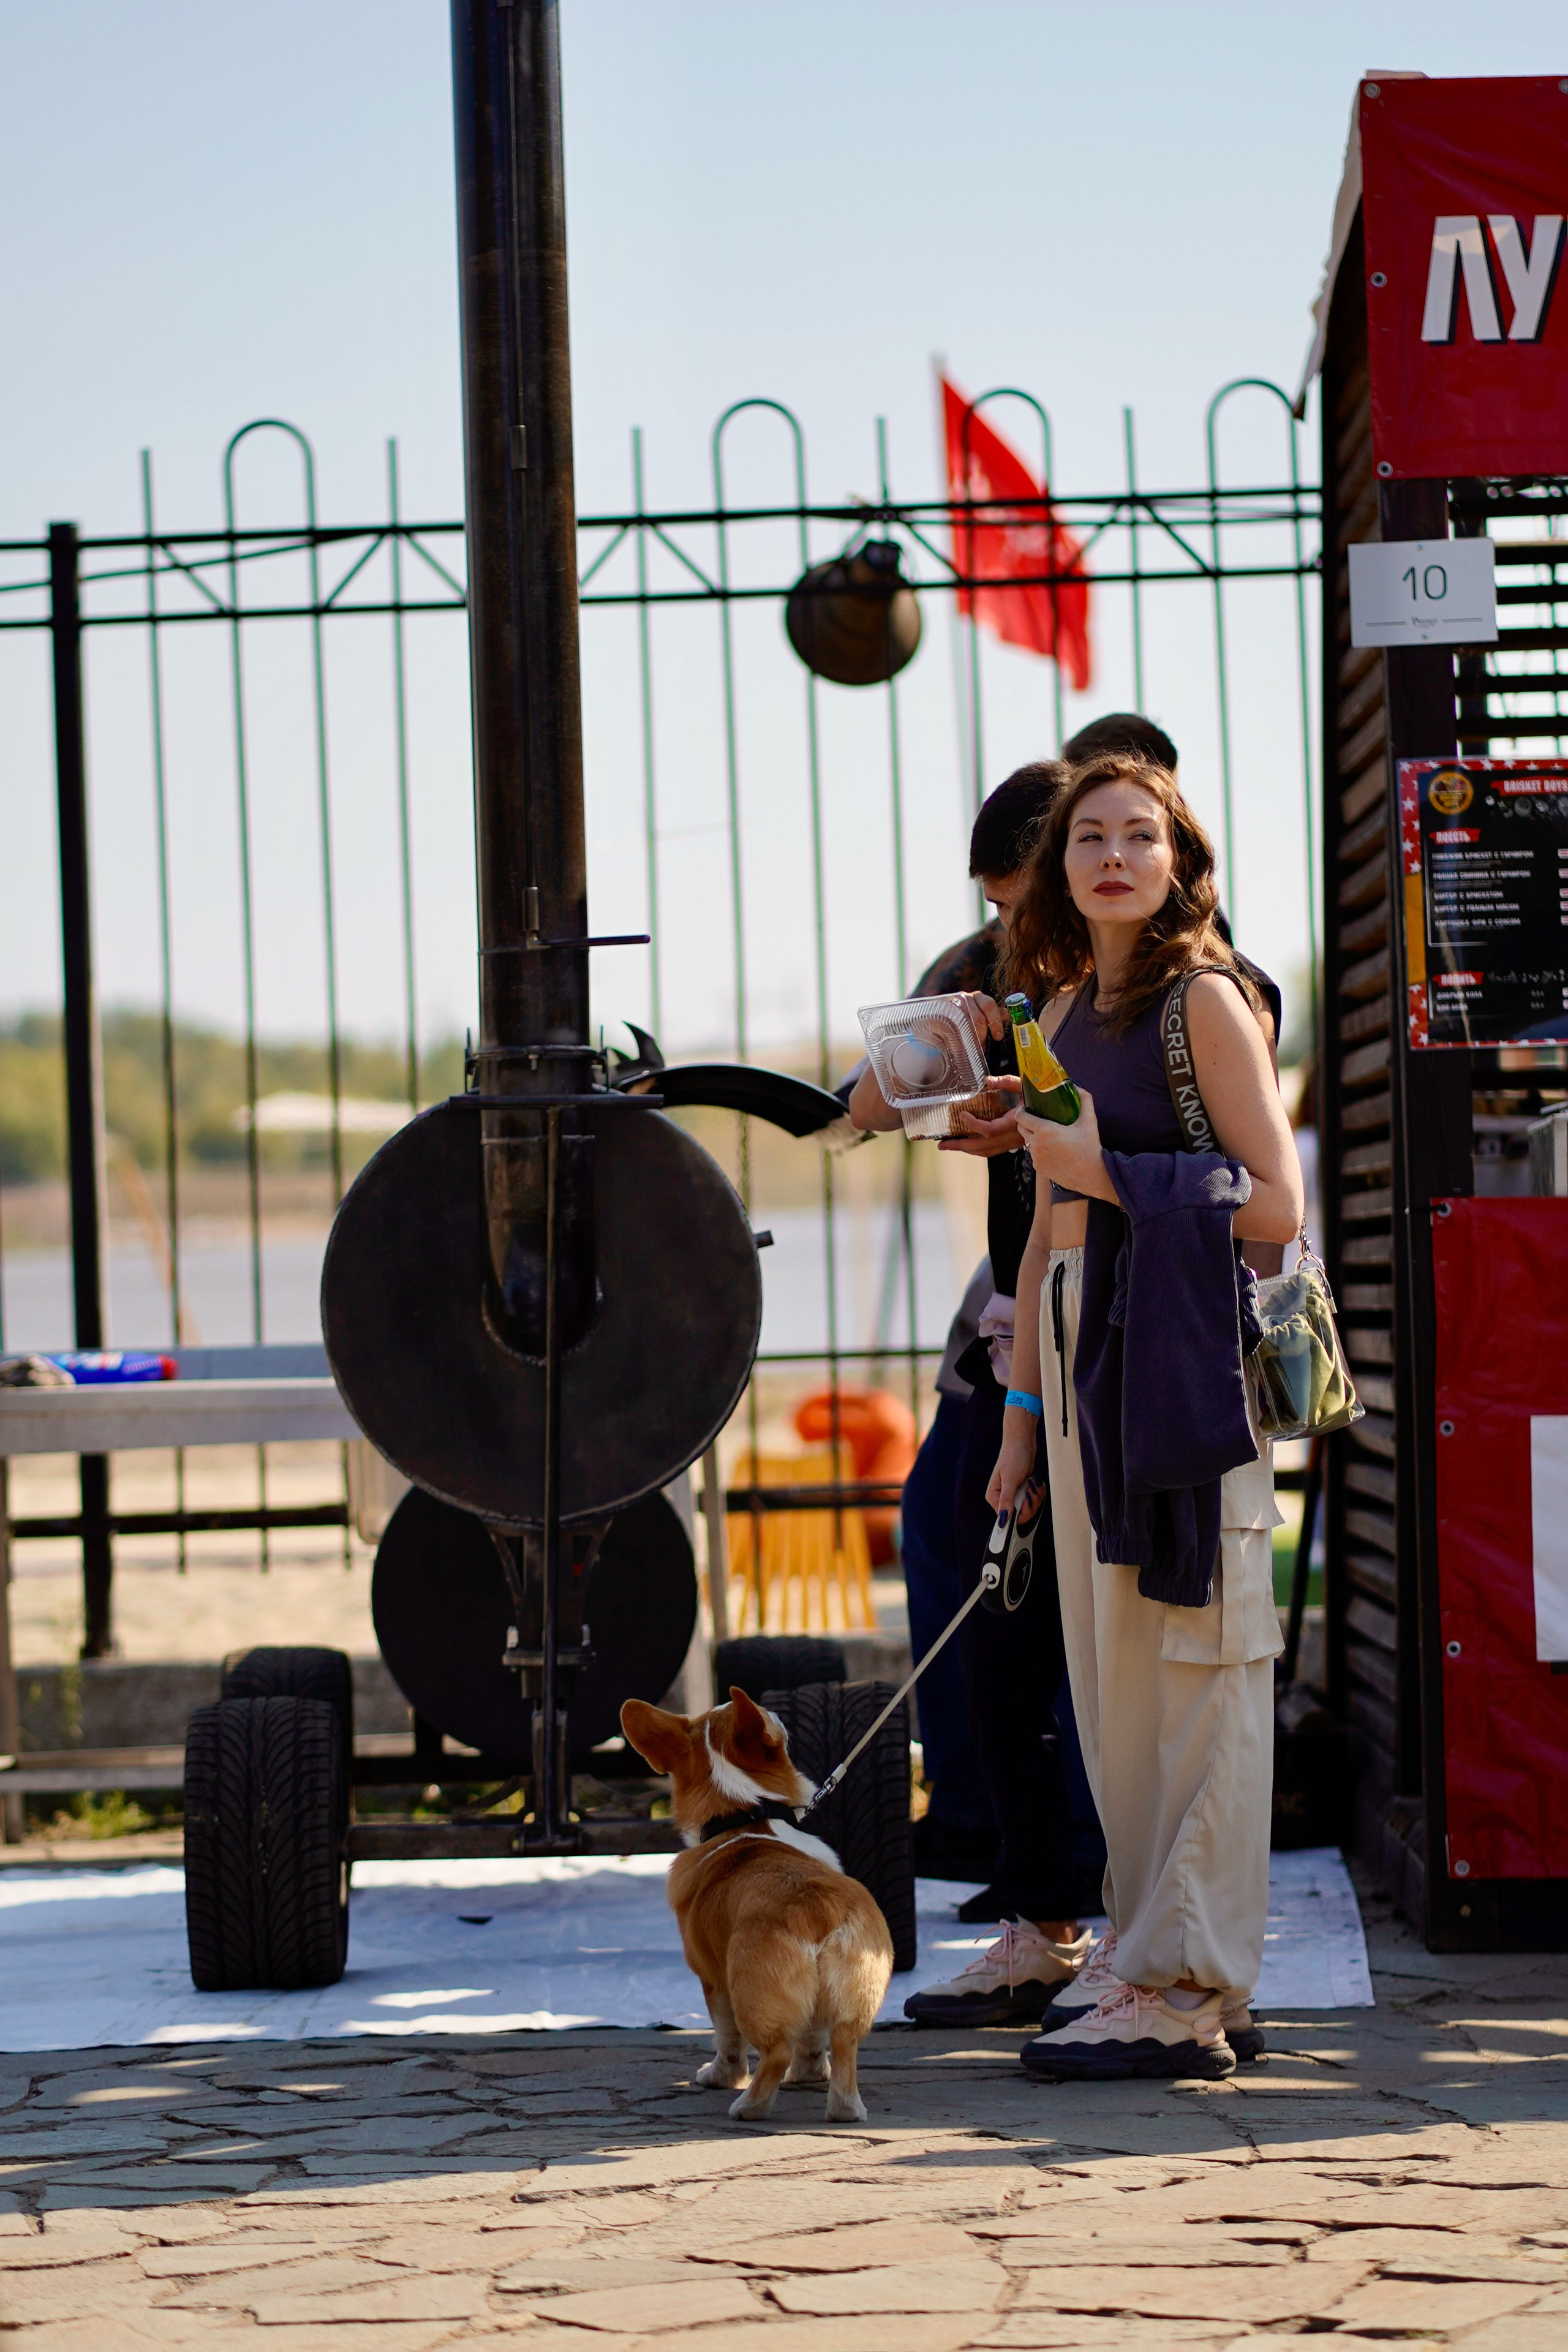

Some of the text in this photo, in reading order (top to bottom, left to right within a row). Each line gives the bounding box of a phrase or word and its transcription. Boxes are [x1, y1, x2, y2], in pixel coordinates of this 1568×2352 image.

[1420, 214, 1568, 342] ЛУ
[1402, 564, 1447, 601] 10
[1504, 780, 1541, 793] BRISKET
[1167, 982, 1214, 1155] SECRET KNOW
